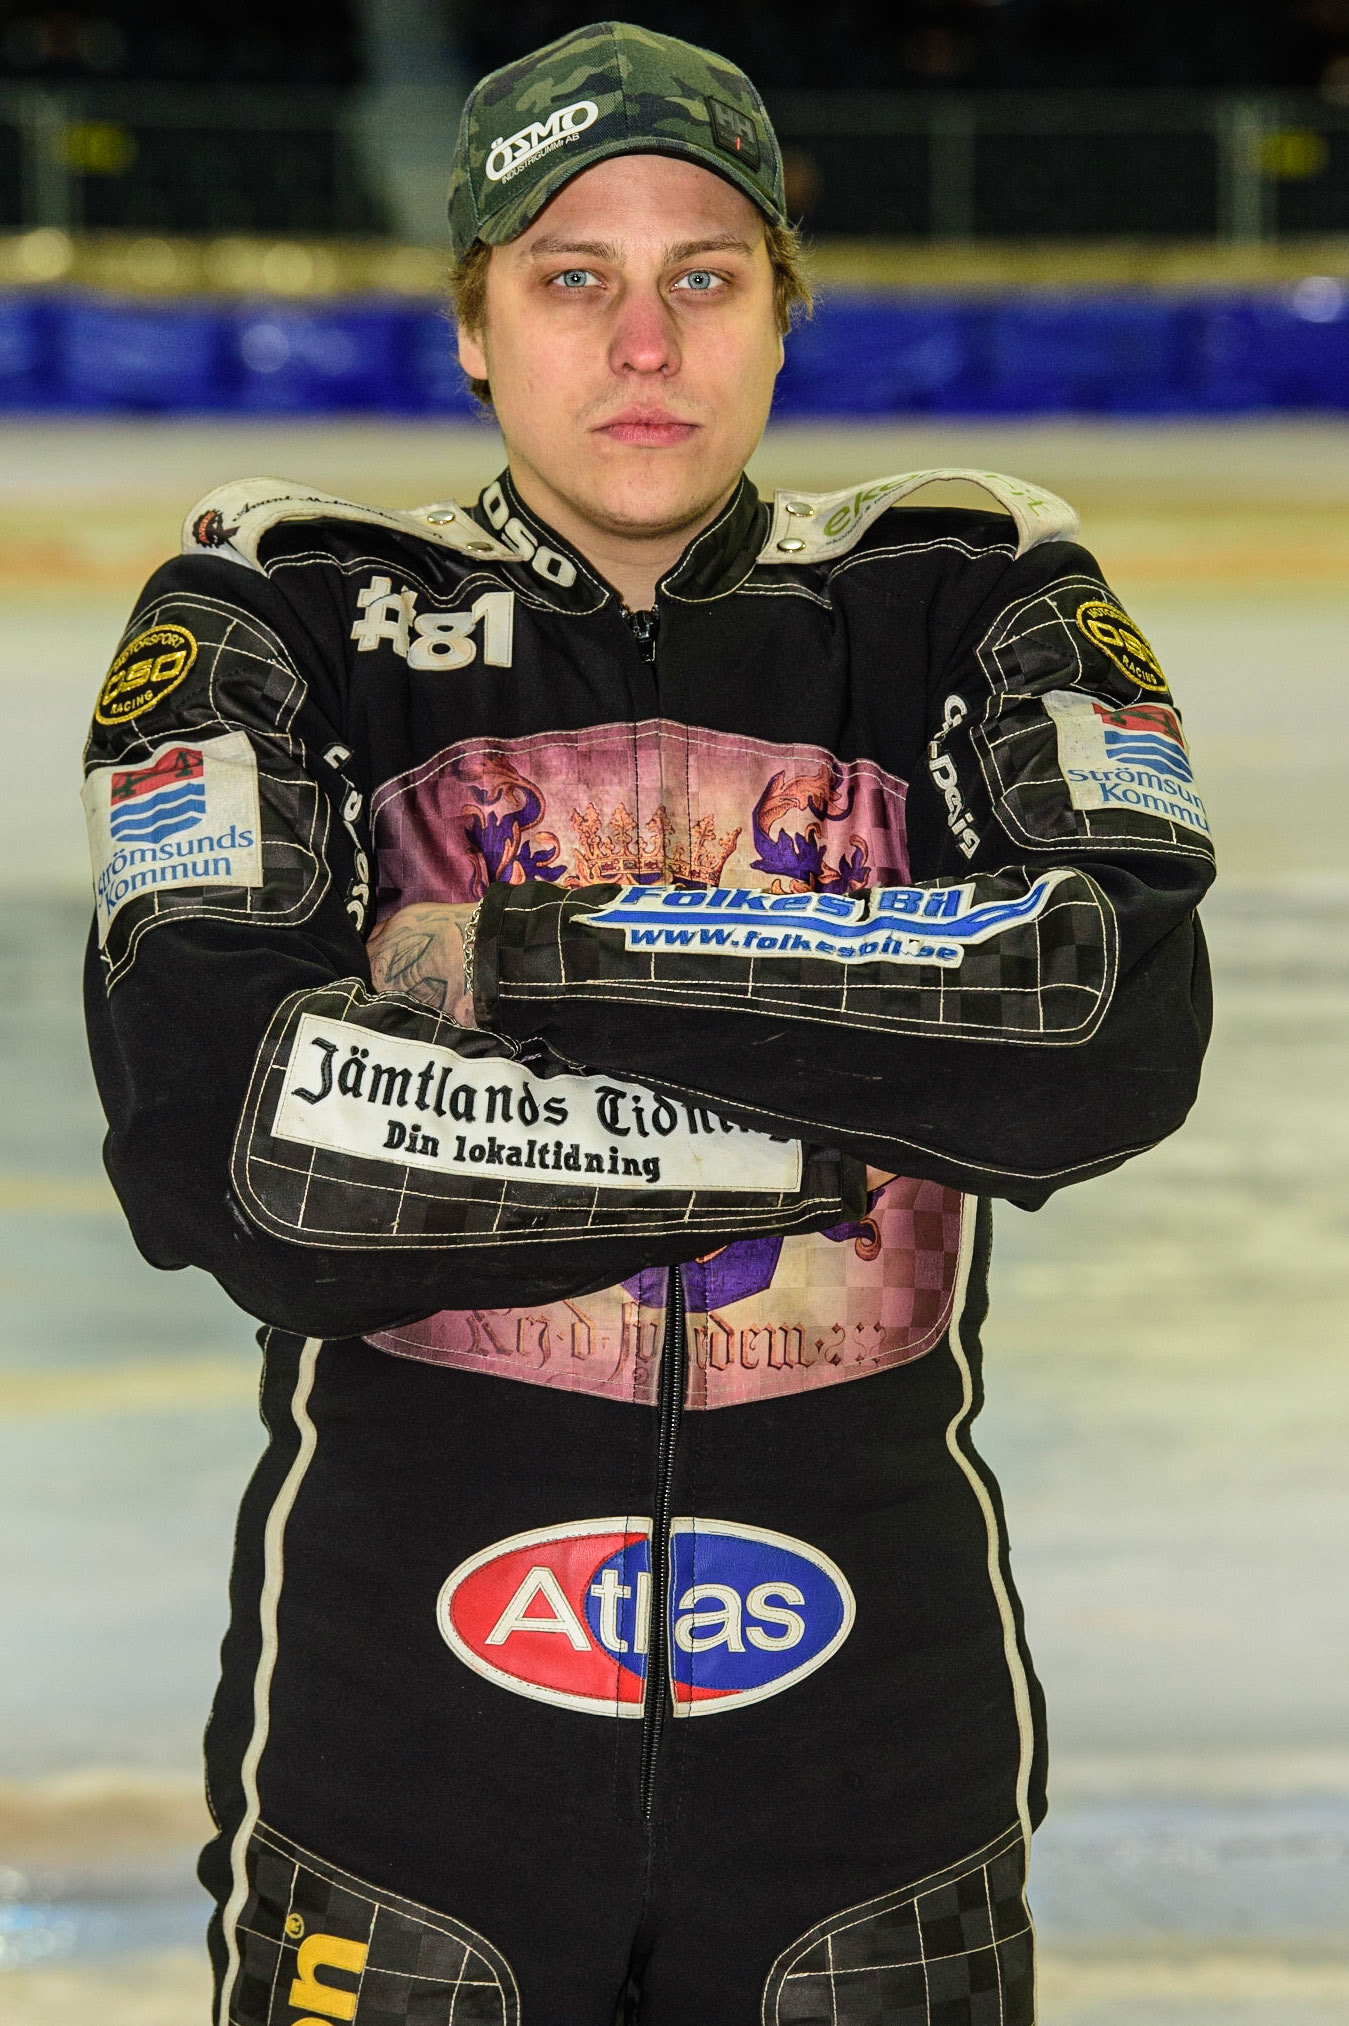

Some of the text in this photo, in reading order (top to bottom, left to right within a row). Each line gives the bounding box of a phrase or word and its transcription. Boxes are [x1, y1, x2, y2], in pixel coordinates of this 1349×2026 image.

[486, 101, 598, 181] ÖSMO
[565, 133, 579, 144] AB
[1122, 654, 1157, 684] RACING
[110, 690, 153, 714] RACING
[620, 886, 962, 918] Folkes Bil
[291, 1037, 569, 1127] Jämtlands
[383, 1119, 660, 1183] Din lokaltidning
[484, 1566, 806, 1655] Atlas
